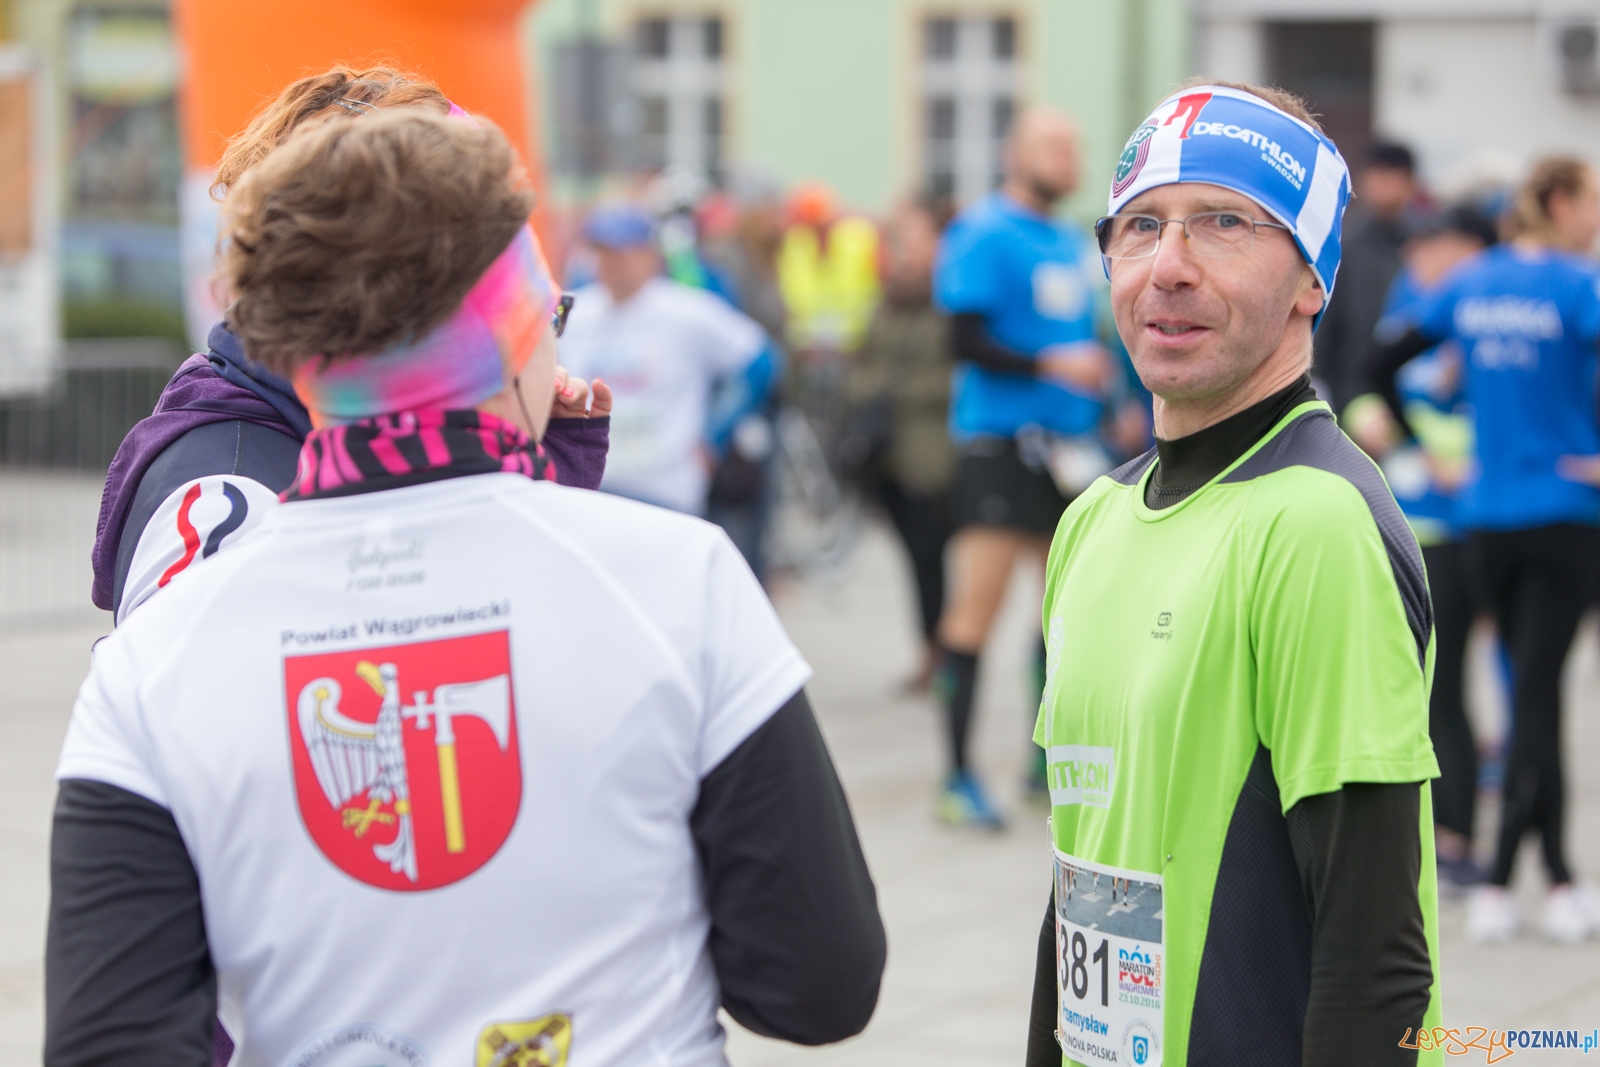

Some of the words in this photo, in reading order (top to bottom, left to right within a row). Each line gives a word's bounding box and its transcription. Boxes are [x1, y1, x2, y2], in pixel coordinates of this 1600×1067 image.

[1192, 121, 1307, 184] DECATHLON
[1260, 152, 1302, 192] SWADZIM
[280, 623, 357, 646] Powiat
[364, 600, 511, 637] Wągrowiecki
[1060, 923, 1109, 1007] 381
[1119, 960, 1155, 977] MARATON
[1062, 1000, 1110, 1036] rzemysław
[1119, 992, 1161, 1010] 23.10.2016
[1086, 1042, 1118, 1064] POLSKA
